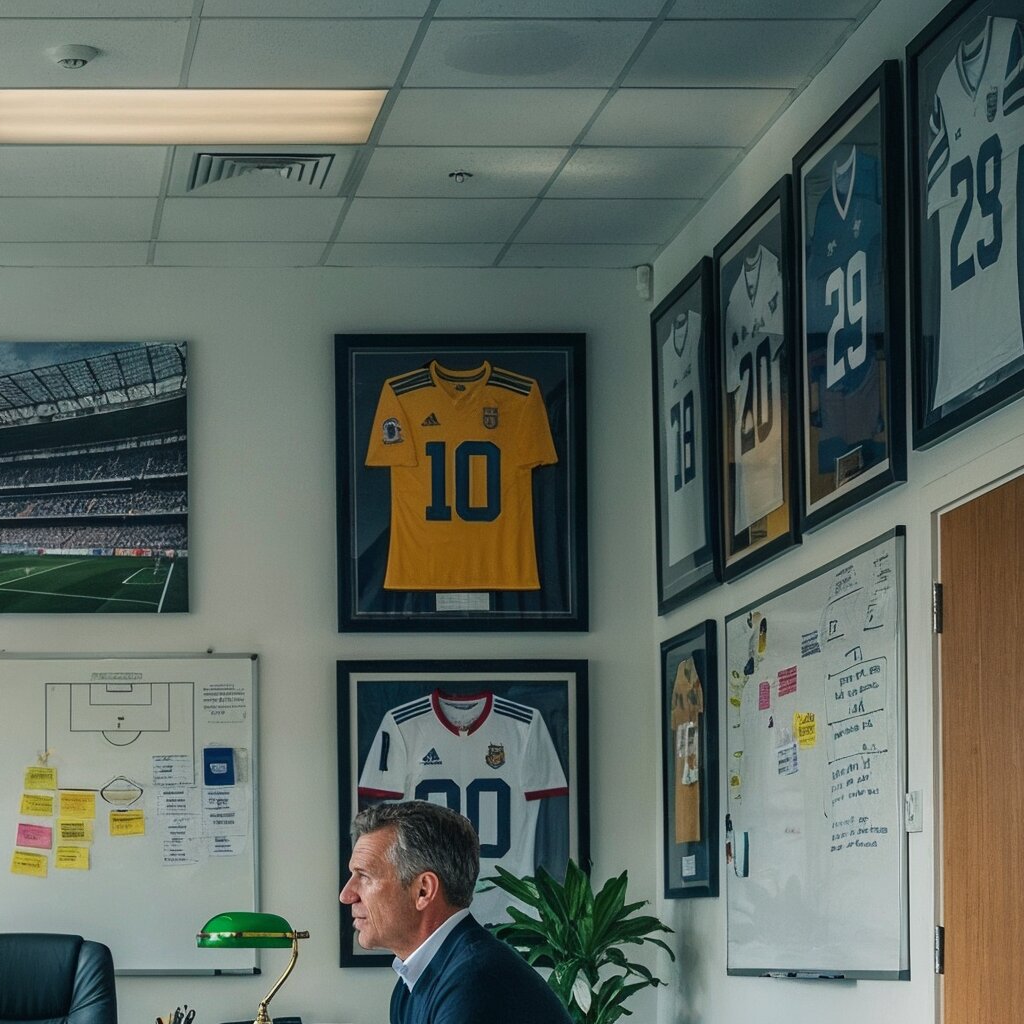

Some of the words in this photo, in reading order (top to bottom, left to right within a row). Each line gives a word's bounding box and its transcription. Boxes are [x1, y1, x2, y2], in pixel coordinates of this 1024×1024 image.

[950, 133, 1003, 290] 29
[825, 251, 868, 389] 29
[739, 336, 774, 456] 20
[425, 441, 502, 521] 10
[414, 778, 511, 859] 0
